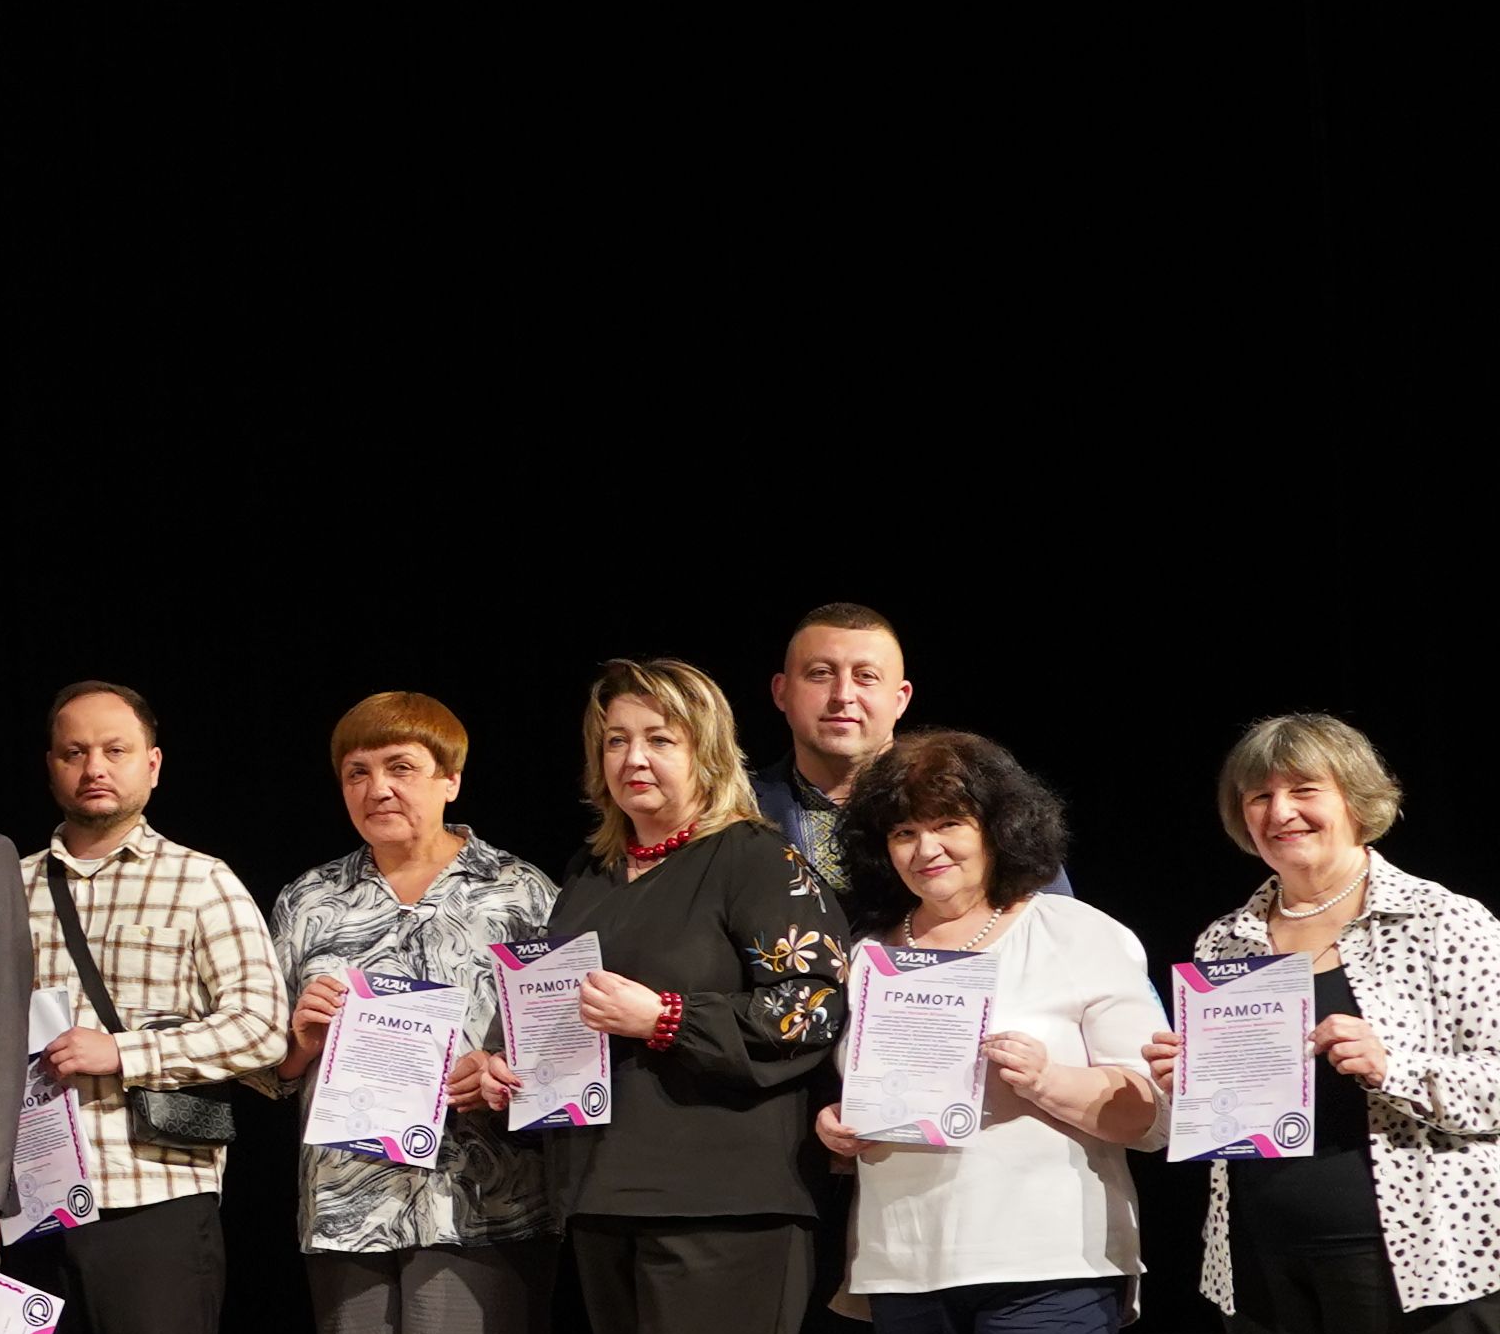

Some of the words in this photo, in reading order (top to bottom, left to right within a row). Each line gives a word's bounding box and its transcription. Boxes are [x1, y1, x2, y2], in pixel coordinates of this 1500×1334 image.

[883, 990, 966, 1007] ГРАМОТА
[1202, 1001, 1285, 1020] ГРАМОТА
[358, 1011, 433, 1035] ГРАМОТА
